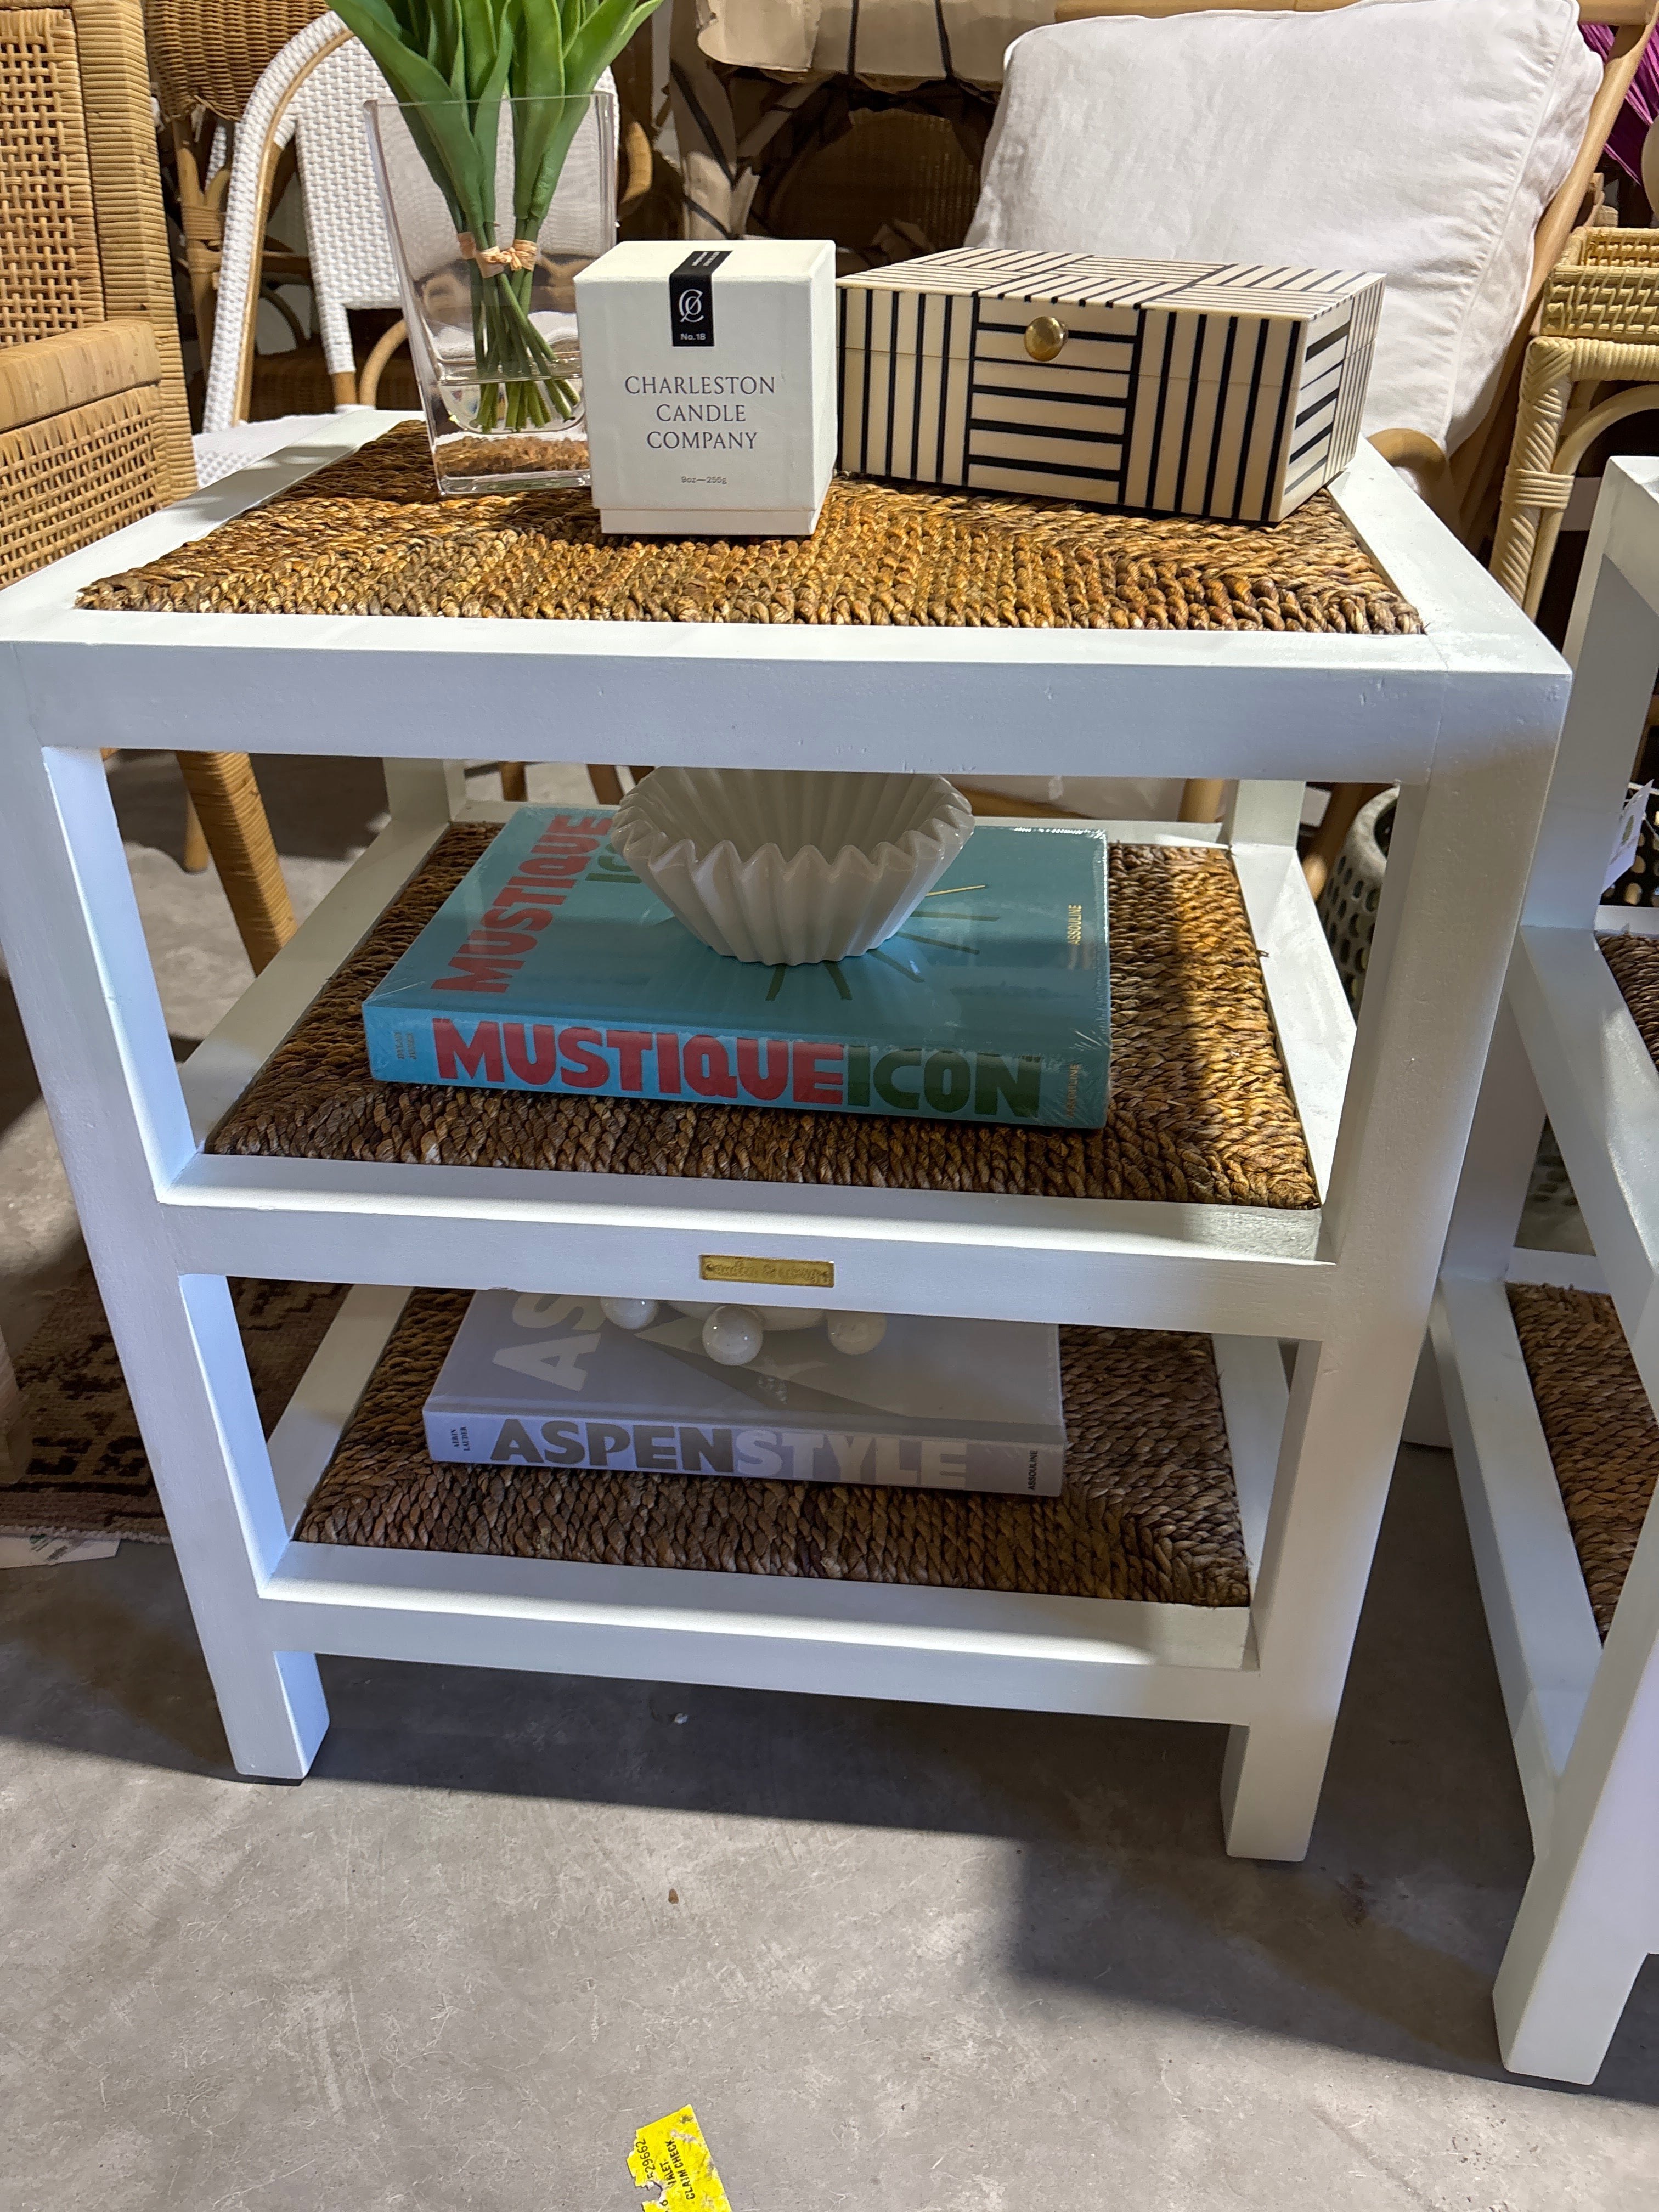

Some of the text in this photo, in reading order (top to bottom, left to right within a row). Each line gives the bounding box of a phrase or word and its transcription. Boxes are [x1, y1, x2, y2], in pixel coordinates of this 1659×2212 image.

[624, 376, 775, 394] CHARLESTON
[656, 404, 747, 422] CANDLE
[646, 431, 758, 449] COMPANY
[585, 843, 643, 884] IC
[431, 815, 613, 993] MUSTIQUE
[1067, 904, 1082, 945] ASSOULINE
[432, 1018, 1042, 1118] MUSTIQUE ICON
[490, 1418, 968, 1488] ASPEN STYLE
[1026, 1449, 1039, 1491] ASSOULINE
[665, 2138, 696, 2200] CLAIM CHECK
